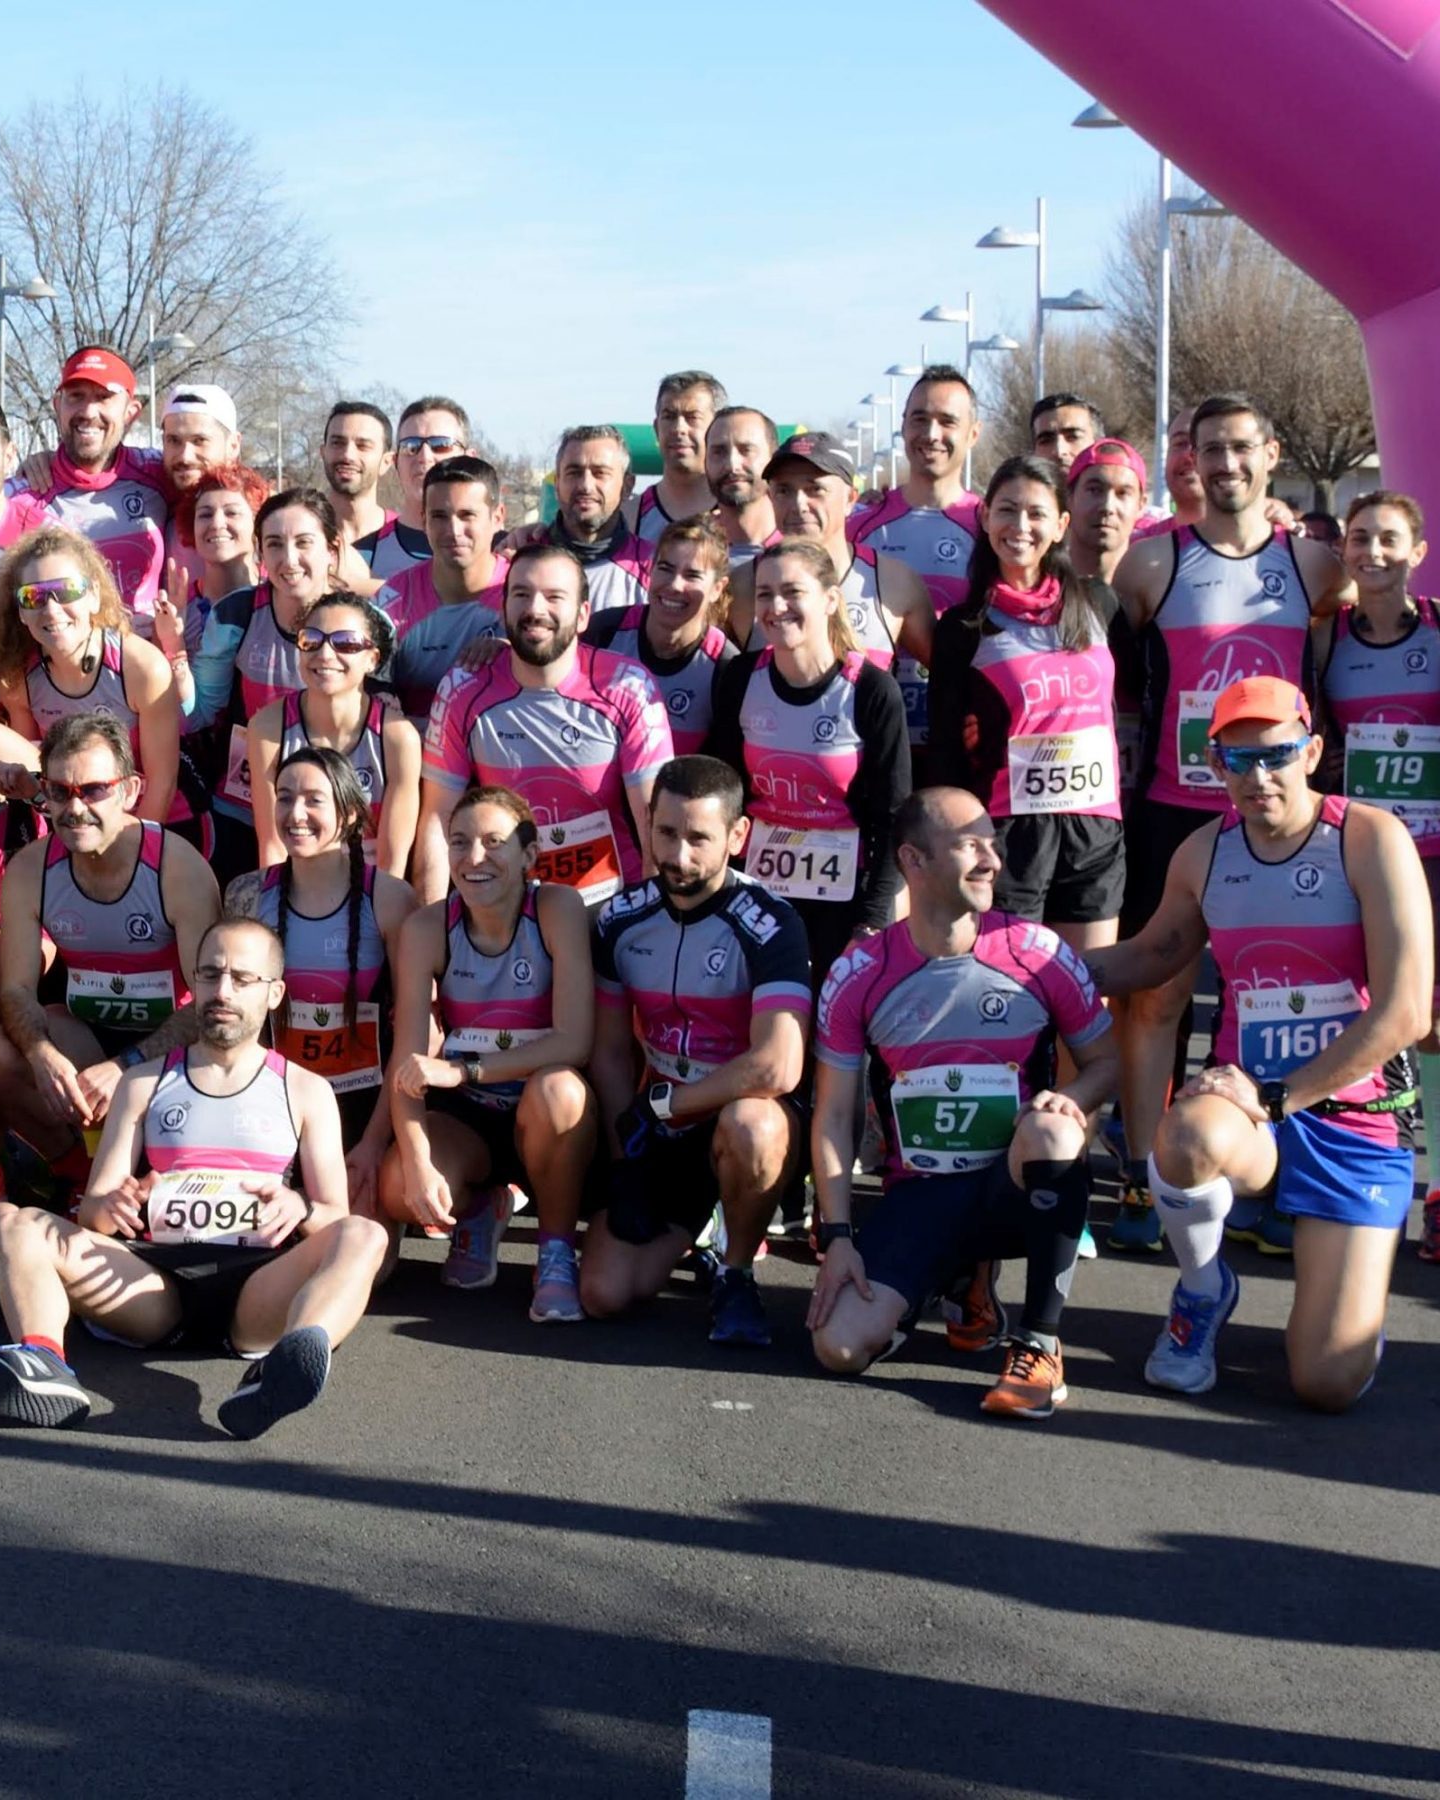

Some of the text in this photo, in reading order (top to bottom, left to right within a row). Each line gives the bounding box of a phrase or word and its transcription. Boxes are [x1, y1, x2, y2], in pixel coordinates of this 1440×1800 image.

[1024, 761, 1103, 796] 5550
[1375, 754, 1425, 785] 119
[757, 848, 841, 882] 5014
[94, 1000, 150, 1021] 775
[301, 1033, 345, 1062] 54
[935, 1101, 980, 1134] 57
[163, 1199, 262, 1232] 5094
